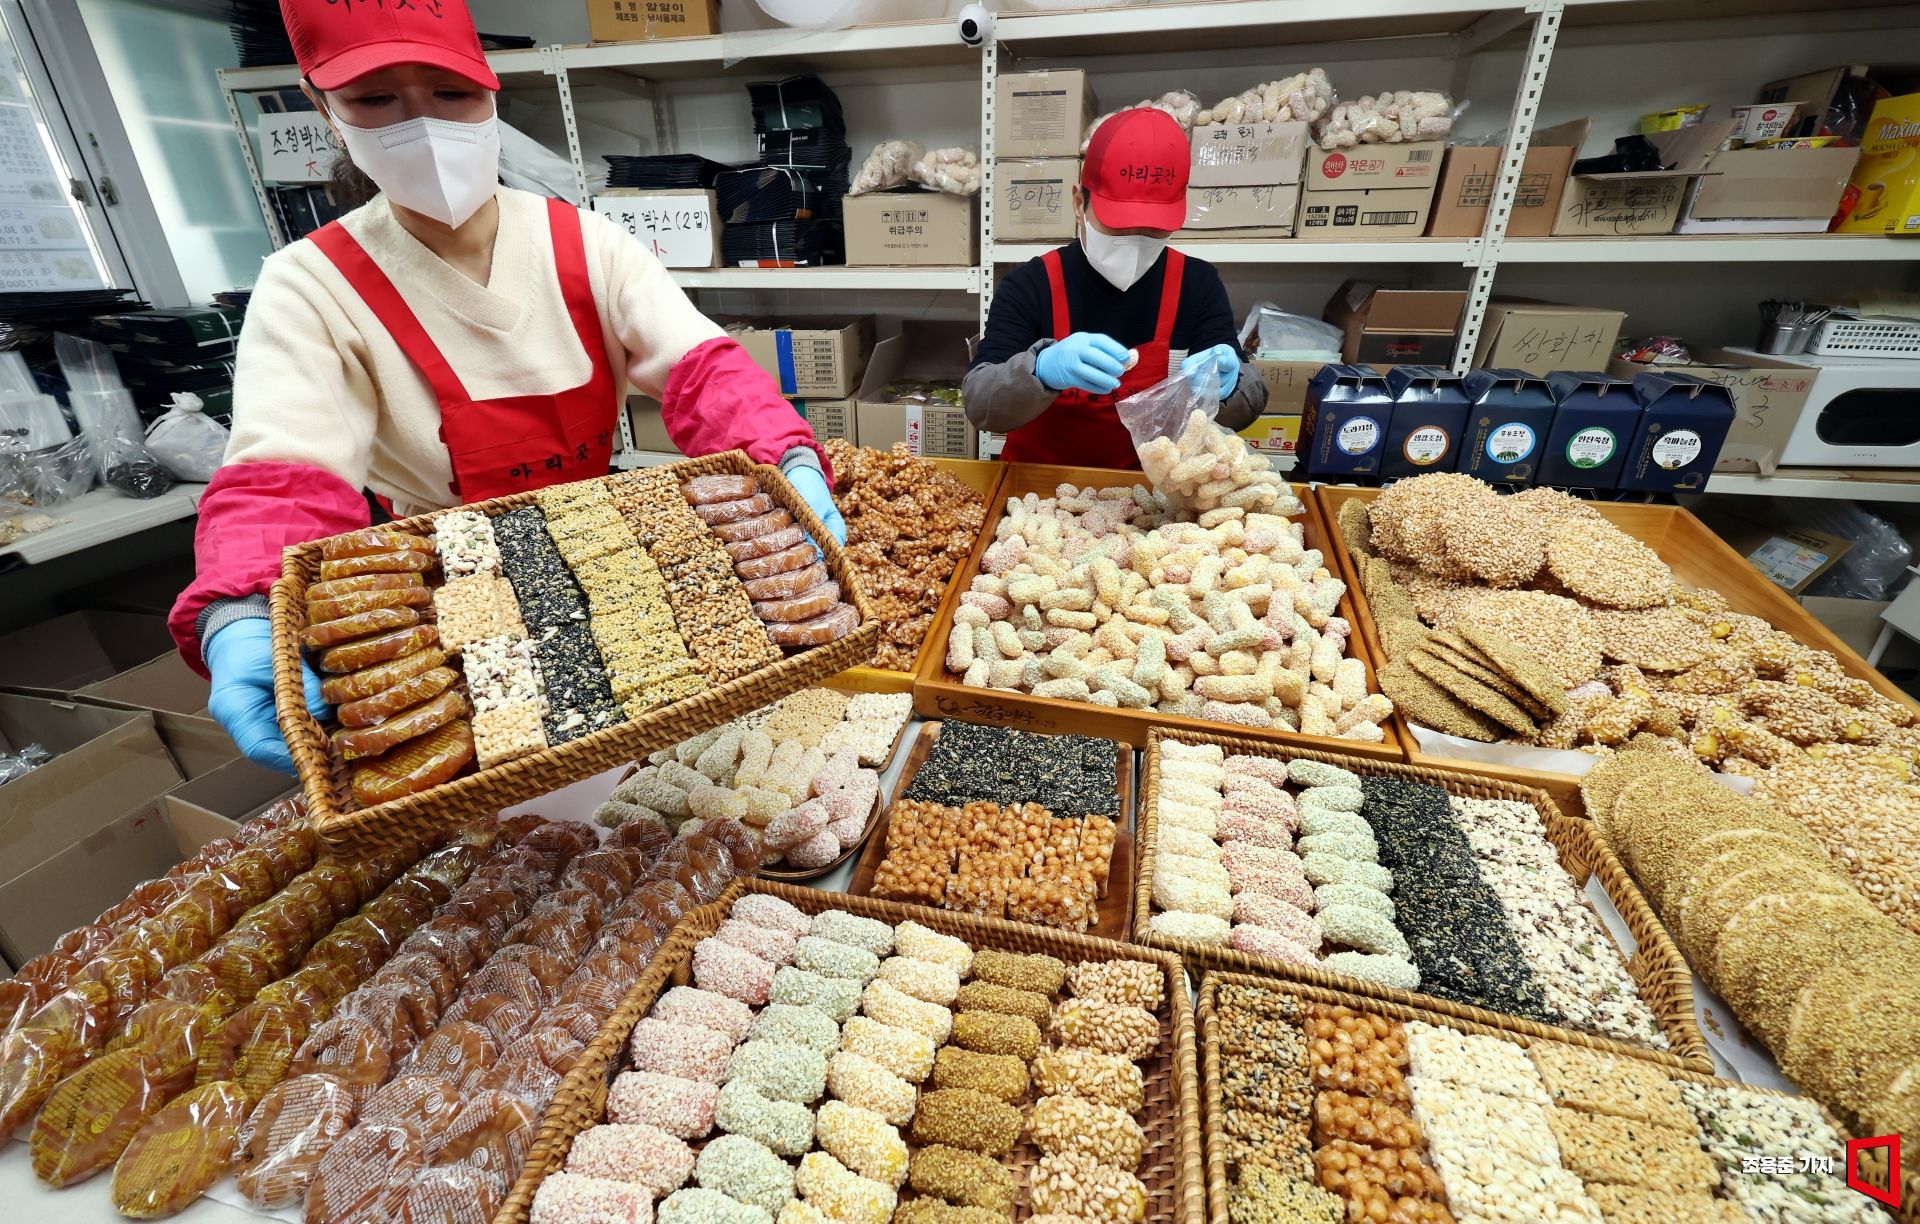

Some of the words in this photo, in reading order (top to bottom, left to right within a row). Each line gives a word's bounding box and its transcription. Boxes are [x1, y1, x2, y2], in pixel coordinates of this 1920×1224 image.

[646, 2, 684, 12] 알알이
[1324, 160, 1346, 173] 햇반
[1349, 159, 1385, 172] 작은공기
[1120, 164, 1176, 186] 아리곳간
[888, 225, 923, 235] 취급주의
[1343, 423, 1373, 434] 도라지청
[1413, 434, 1443, 442] 생강조청
[1578, 435, 1610, 445] 인진쑥청
[1662, 436, 1698, 446] 흑마늘청
